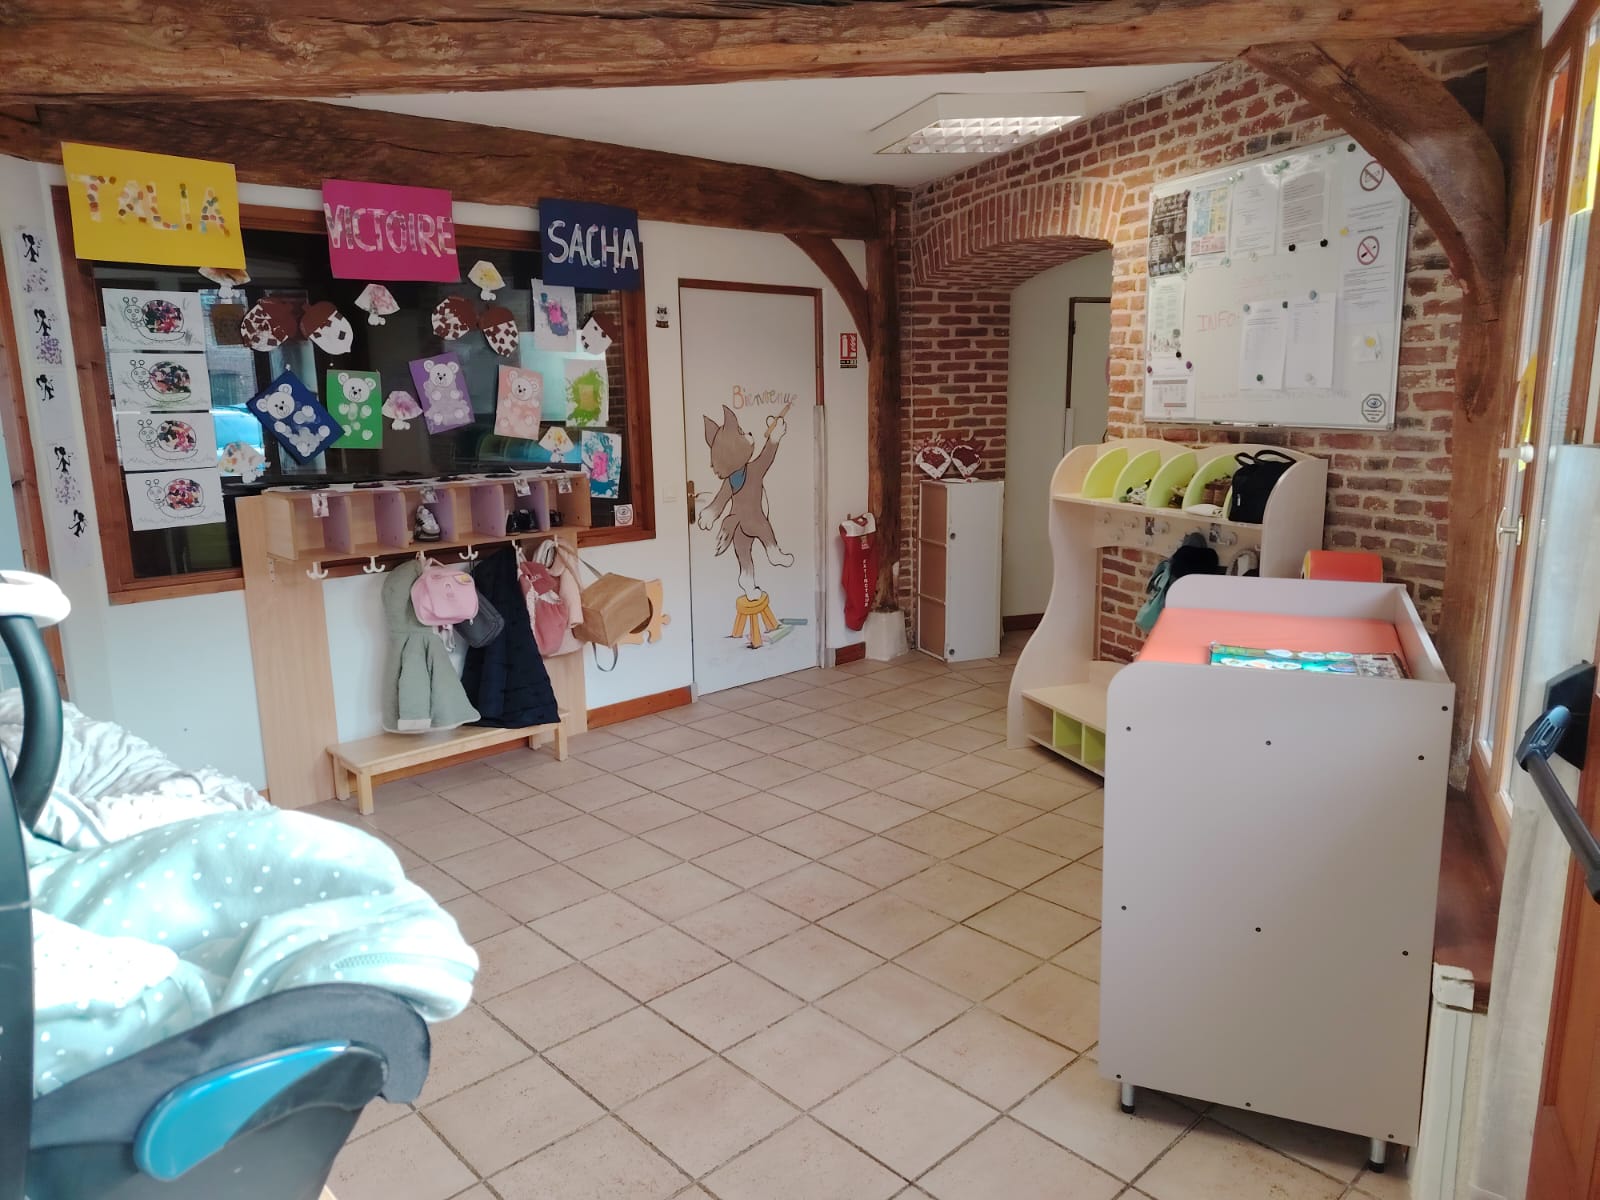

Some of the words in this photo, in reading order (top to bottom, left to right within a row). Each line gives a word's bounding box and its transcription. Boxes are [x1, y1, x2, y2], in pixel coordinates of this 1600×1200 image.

[70, 174, 231, 237] TALIA
[323, 202, 457, 258] VICTOIRE
[547, 219, 639, 274] SACHA
